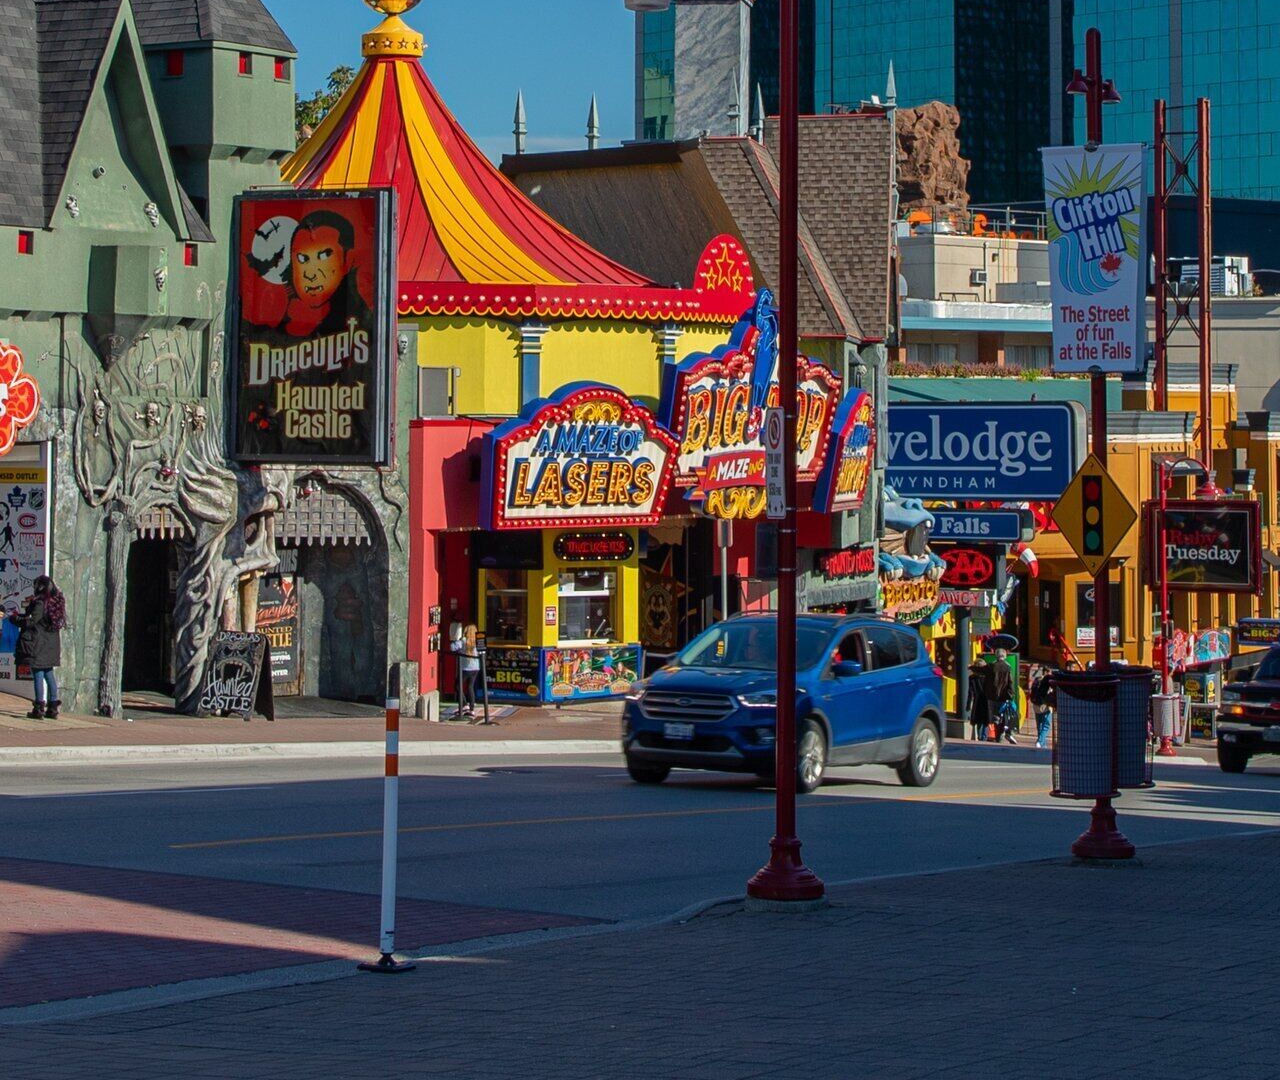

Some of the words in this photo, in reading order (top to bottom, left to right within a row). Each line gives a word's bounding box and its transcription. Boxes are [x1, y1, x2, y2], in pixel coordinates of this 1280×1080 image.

[1053, 186, 1135, 234] Clifton
[1078, 219, 1126, 261] Hill
[1060, 306, 1086, 322] The
[1089, 305, 1129, 322] Street
[1076, 324, 1092, 341] of
[1092, 324, 1114, 341] fun
[1060, 345, 1073, 360] at
[1076, 343, 1098, 359] the
[1102, 342, 1131, 359] Falls
[276, 379, 365, 413] Haunted
[284, 408, 352, 439] Castle
[681, 384, 751, 454] BIG
[554, 425, 617, 454] MAZE
[618, 428, 644, 451] OF
[515, 457, 656, 507] LASERS
[890, 477, 996, 489] WYNDHAM
[940, 516, 990, 534] Falls
[1169, 529, 1218, 547] Ruby
[1166, 544, 1241, 565] Tuesday
[1251, 629, 1269, 638] BIG
[201, 660, 258, 698] Haunted
[496, 671, 521, 683] BIG
[200, 696, 252, 711] CASTLE
